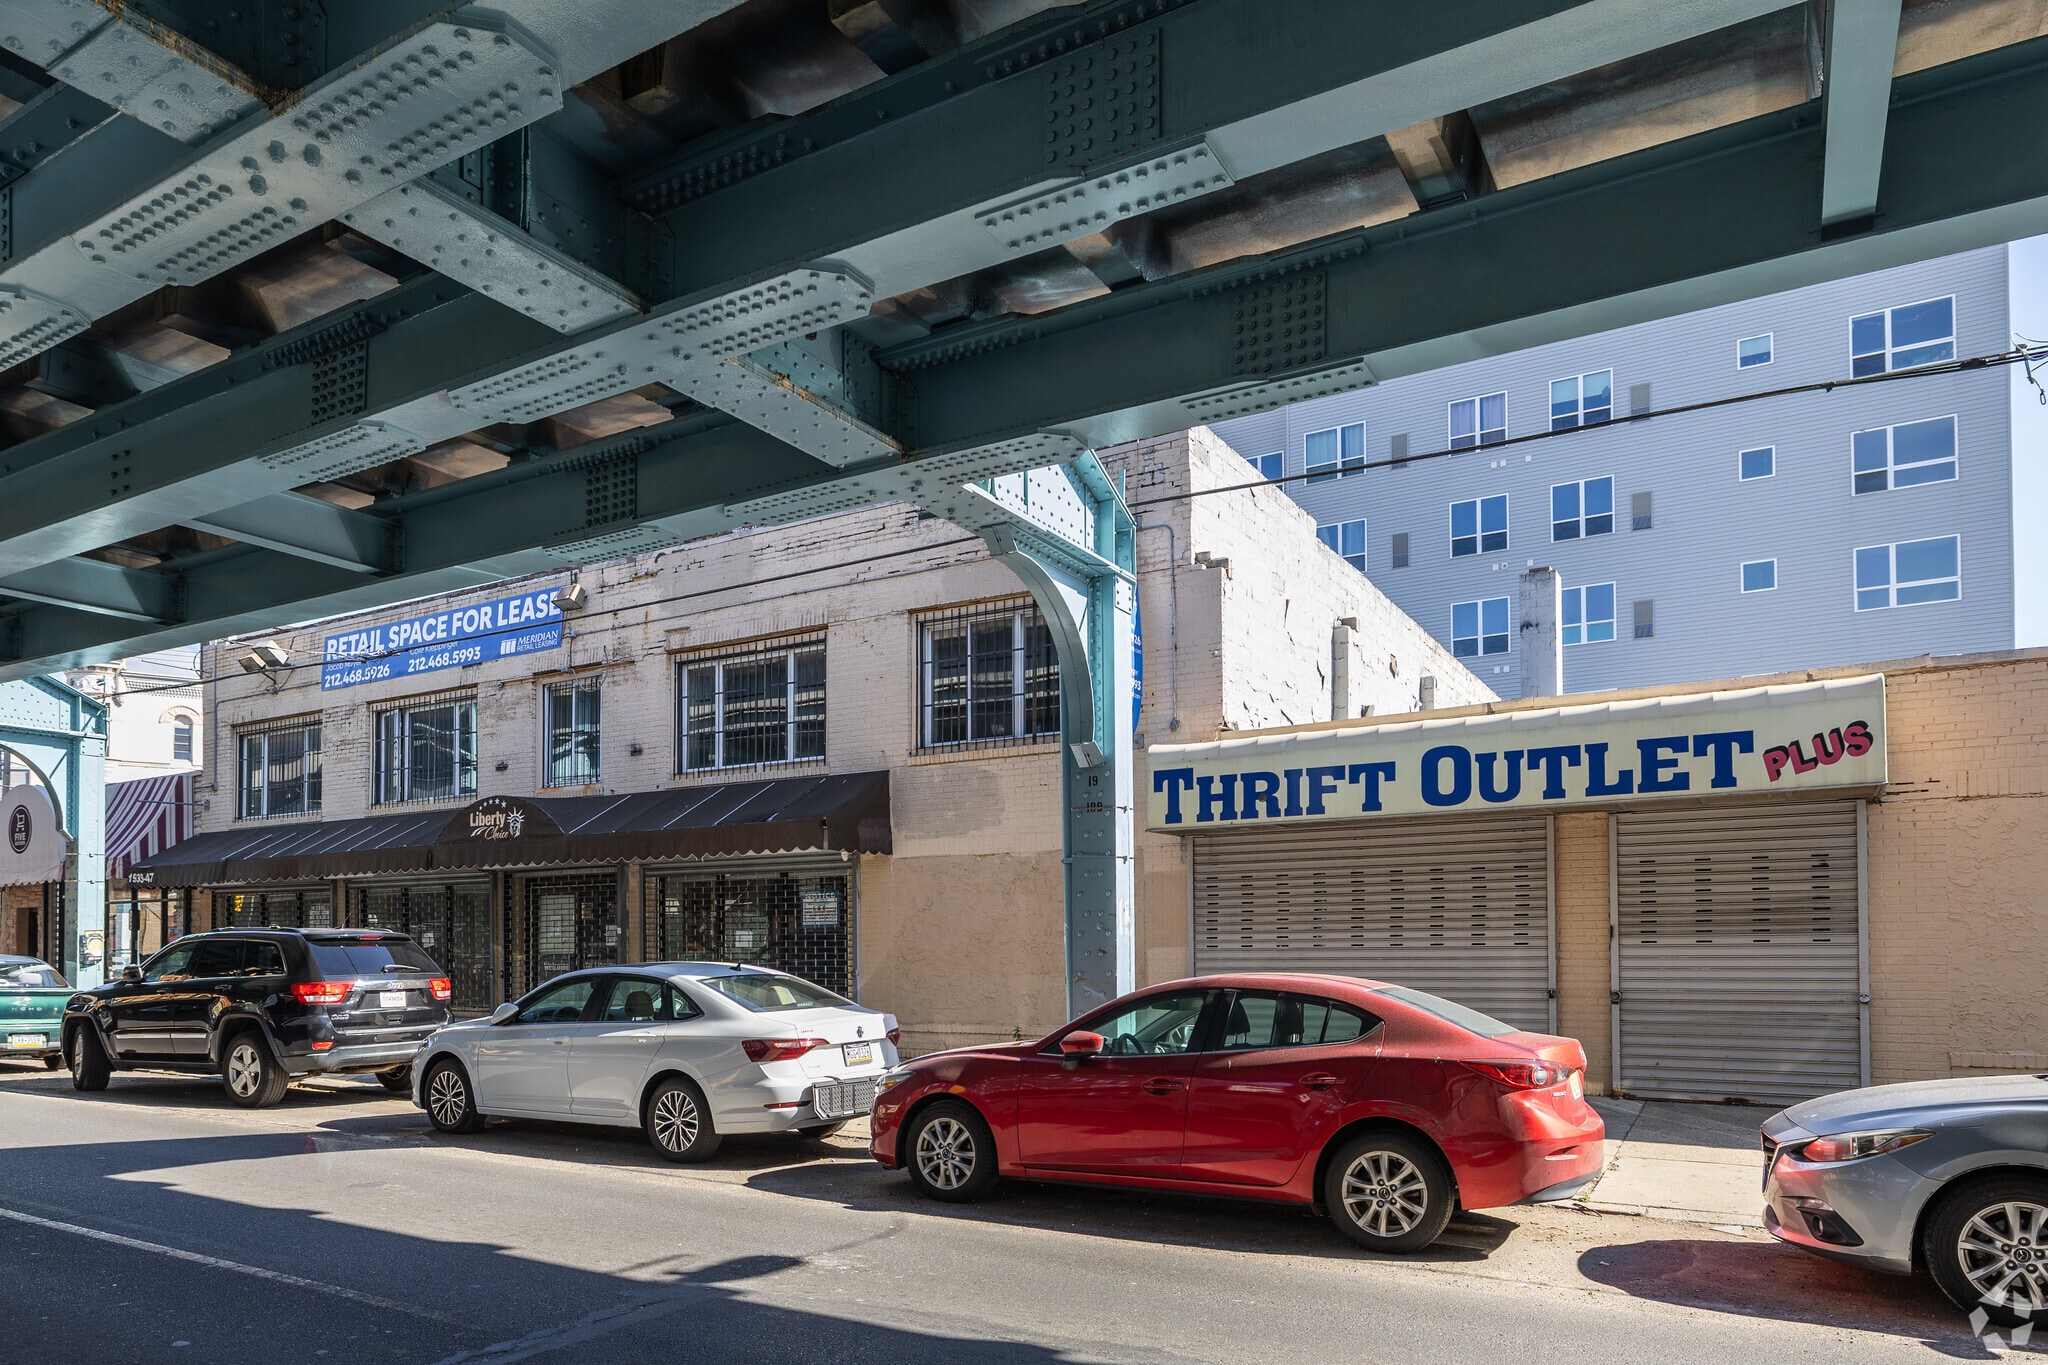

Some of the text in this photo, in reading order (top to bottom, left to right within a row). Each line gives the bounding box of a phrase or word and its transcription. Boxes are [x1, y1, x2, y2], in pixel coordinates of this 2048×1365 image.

[326, 591, 561, 661] RETAIL SPACE FOR LEASE
[517, 629, 559, 645] MERIDIAN
[517, 639, 558, 653] RETAIL LEASING
[407, 646, 482, 673] 212.468.5993
[324, 664, 390, 688] 212.468.5926
[1153, 719, 1875, 825] THRIFT OUTLET PLUS
[1089, 775, 1098, 787] 19
[469, 811, 506, 828] Liberty
[484, 826, 509, 841] Choice
